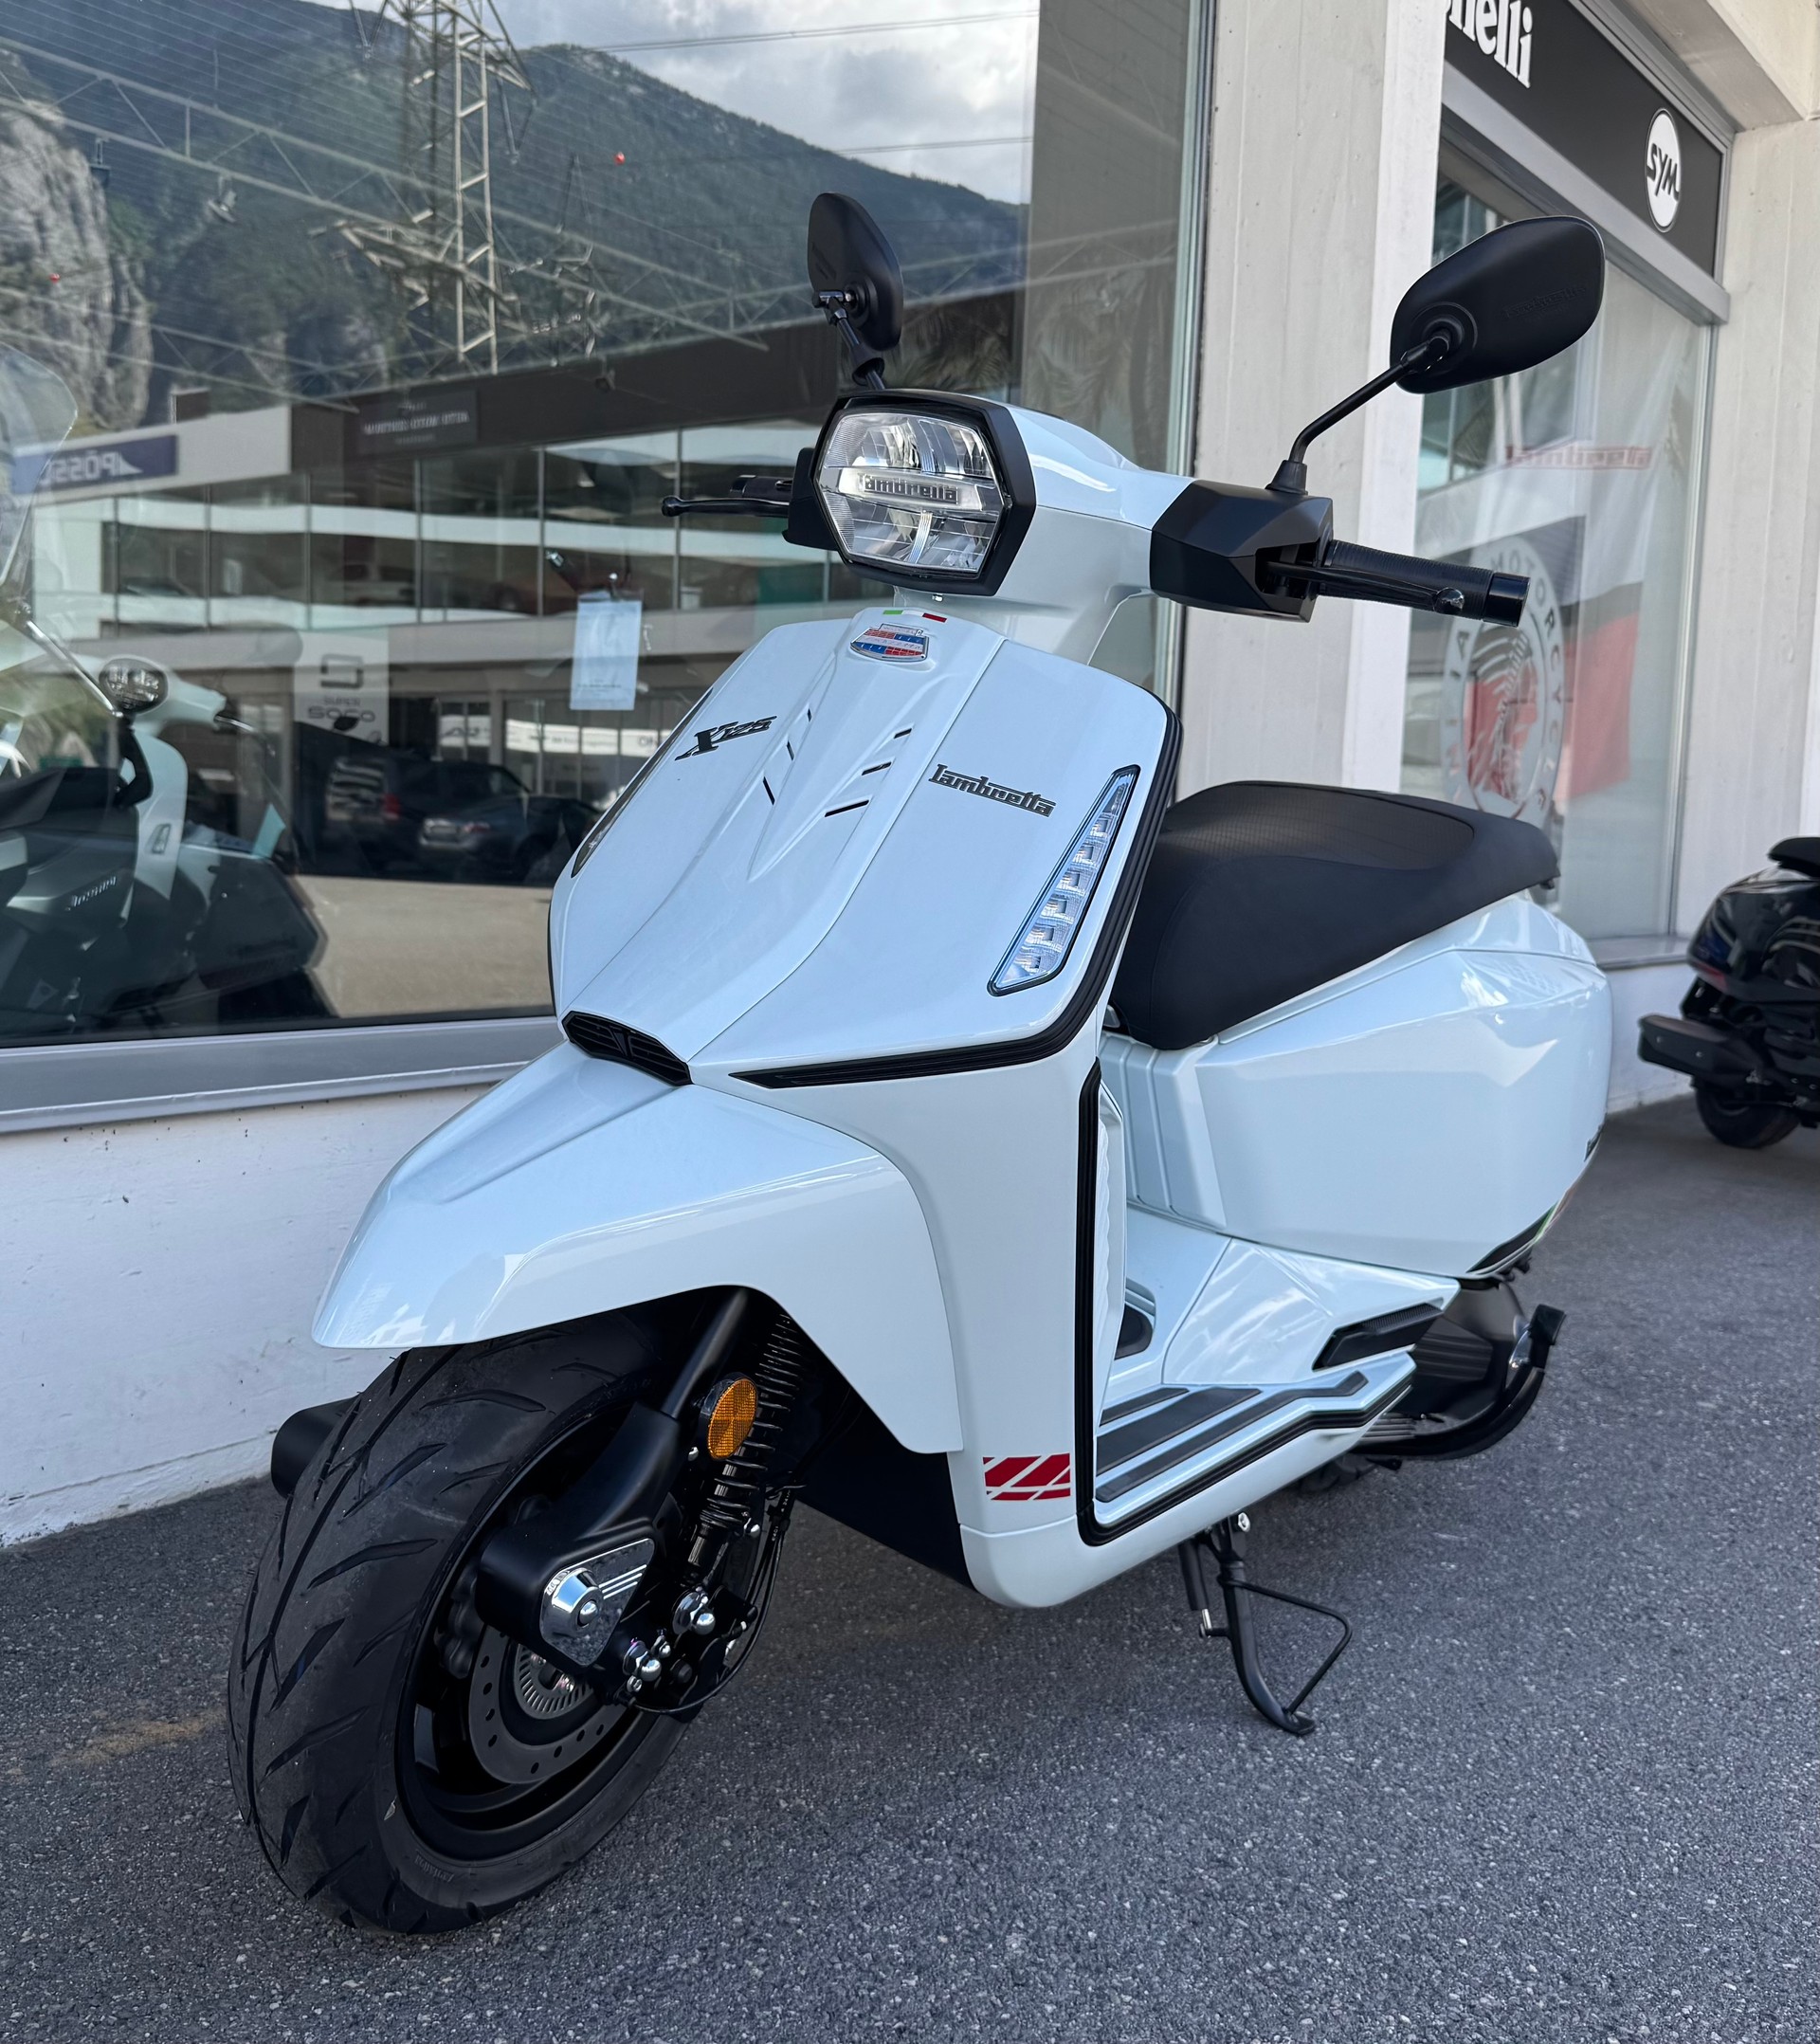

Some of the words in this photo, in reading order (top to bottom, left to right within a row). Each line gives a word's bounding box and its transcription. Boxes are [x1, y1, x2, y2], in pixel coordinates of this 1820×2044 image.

[1445, 0, 1533, 89] nelli
[1647, 143, 1680, 202] SYM
[928, 763, 1057, 817] Lambretta
